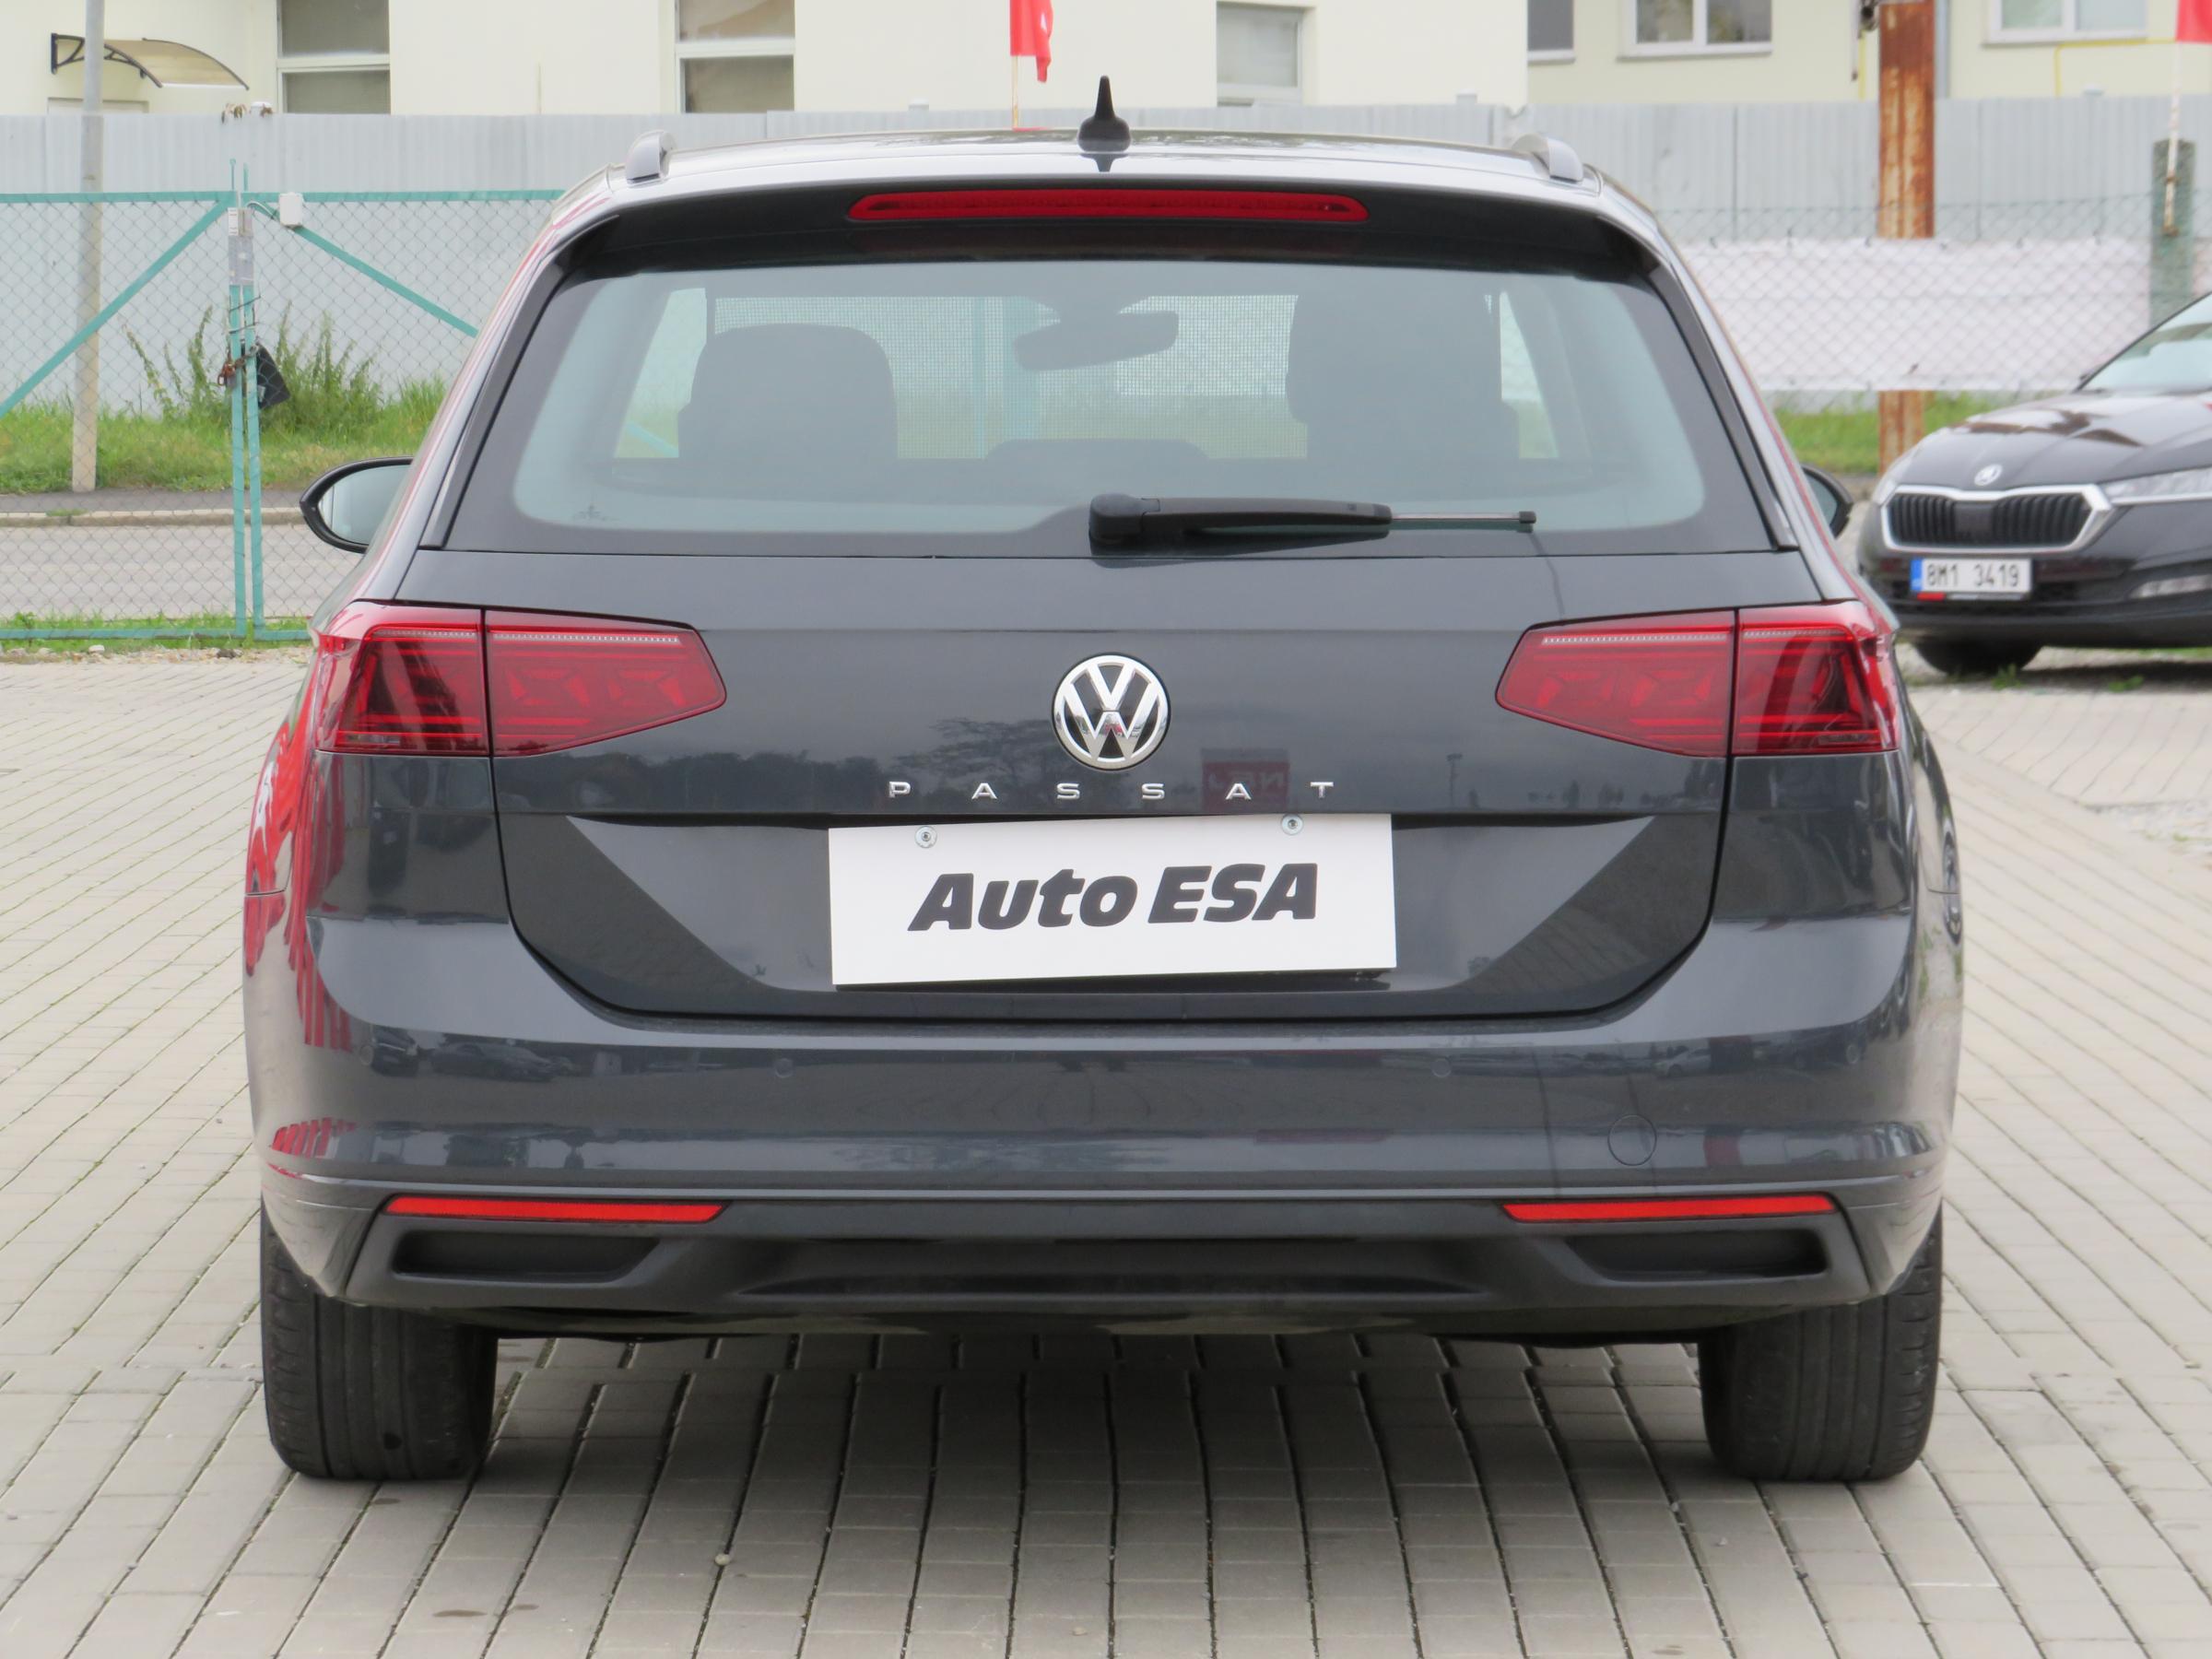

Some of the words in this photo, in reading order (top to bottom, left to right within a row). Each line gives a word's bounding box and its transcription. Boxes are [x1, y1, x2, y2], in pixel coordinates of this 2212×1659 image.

[1926, 563, 1959, 587] 8M1
[1973, 563, 2019, 587] 3419
[1057, 655, 1168, 768] VW
[888, 781, 1335, 801] PASSAT
[907, 868, 1138, 932] Auto
[1147, 863, 1318, 924] ESA
